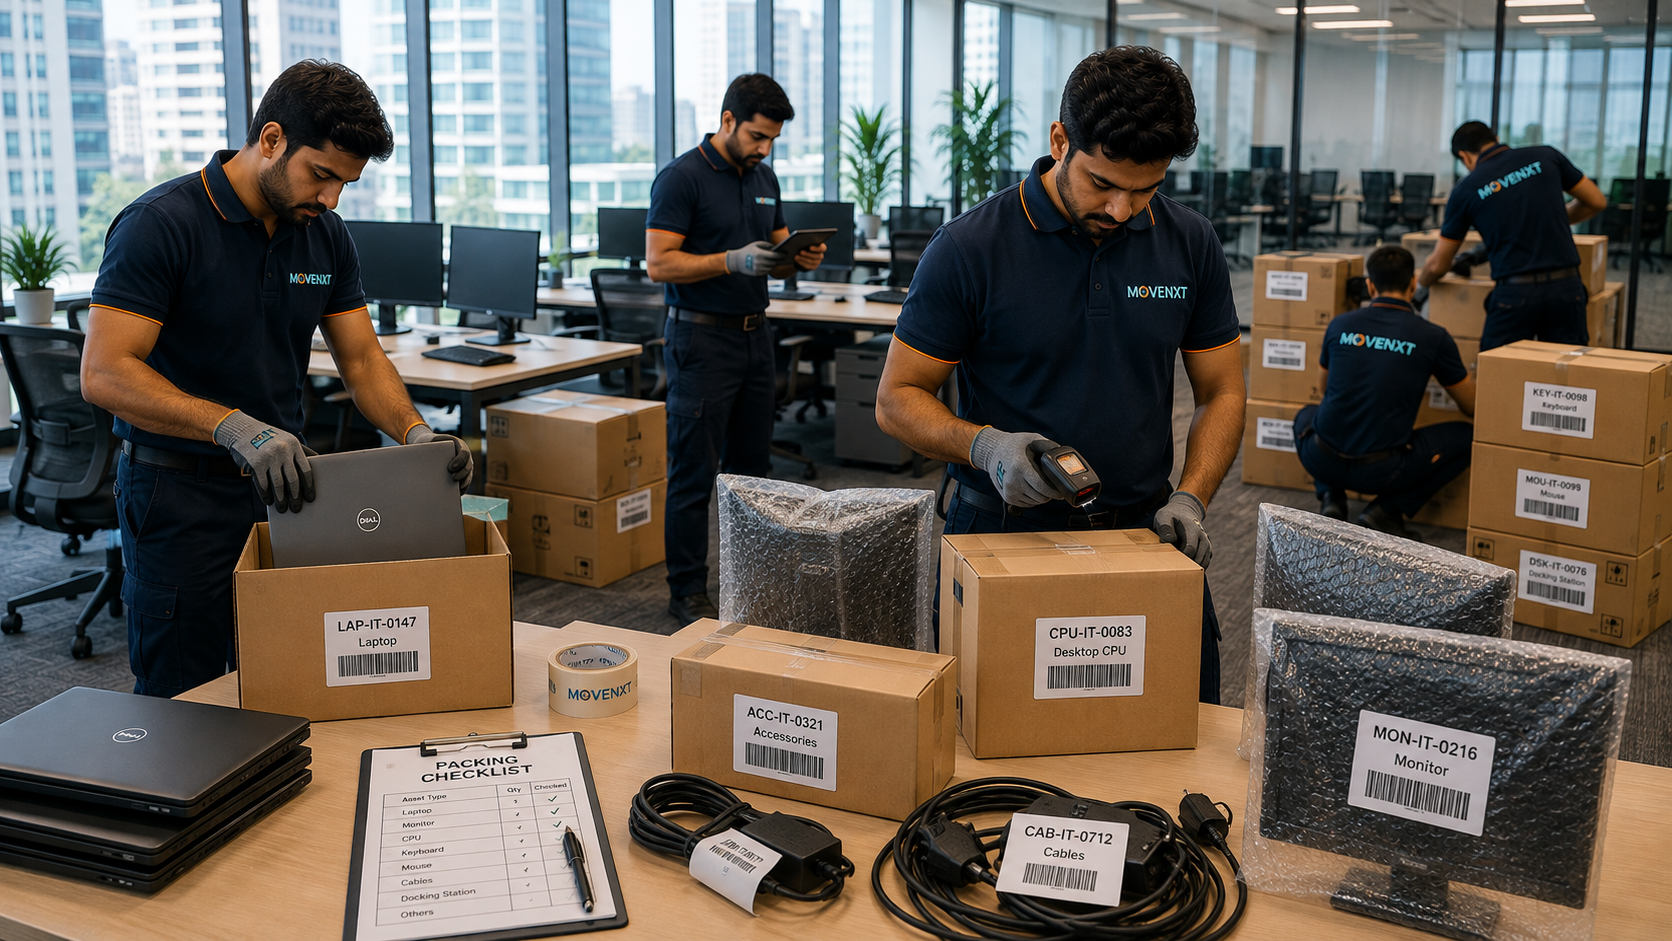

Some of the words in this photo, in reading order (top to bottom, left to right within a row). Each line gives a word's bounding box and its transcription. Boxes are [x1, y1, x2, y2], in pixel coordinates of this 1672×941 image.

[1477, 161, 1543, 200] MOVENXT
[290, 272, 332, 285] MOVENXT
[1127, 285, 1188, 299] MOVENXT
[1339, 332, 1416, 356] MOVENXT
[1533, 388, 1588, 402] KEY-IT-0098
[1529, 557, 1587, 576] DSK-IT-0076
[338, 616, 416, 632] LAP-IT-0147
[1049, 625, 1132, 639] CPU-IT-0083
[358, 637, 397, 648] Laptop
[1054, 647, 1099, 658] Desktop
[1102, 645, 1126, 656] CPU
[568, 680, 632, 701] MOVENXT
[747, 706, 823, 731] ACC-IT-0321
[753, 726, 817, 747] Accessories
[1373, 725, 1478, 760] MON-IT-0216
[436, 755, 518, 770] PACKING
[1394, 753, 1449, 776] Monitor
[421, 764, 532, 783] CHECKLIST
[402, 808, 432, 816] Laptop
[402, 820, 435, 829] Monitor
[1024, 825, 1113, 845] CAB-IT-0712
[401, 846, 444, 857] Keyboard
[1043, 847, 1085, 861] Cables
[401, 863, 432, 871] Mouse
[401, 892, 440, 902] Docking
[443, 888, 476, 898] Station
[400, 909, 434, 919] Others
